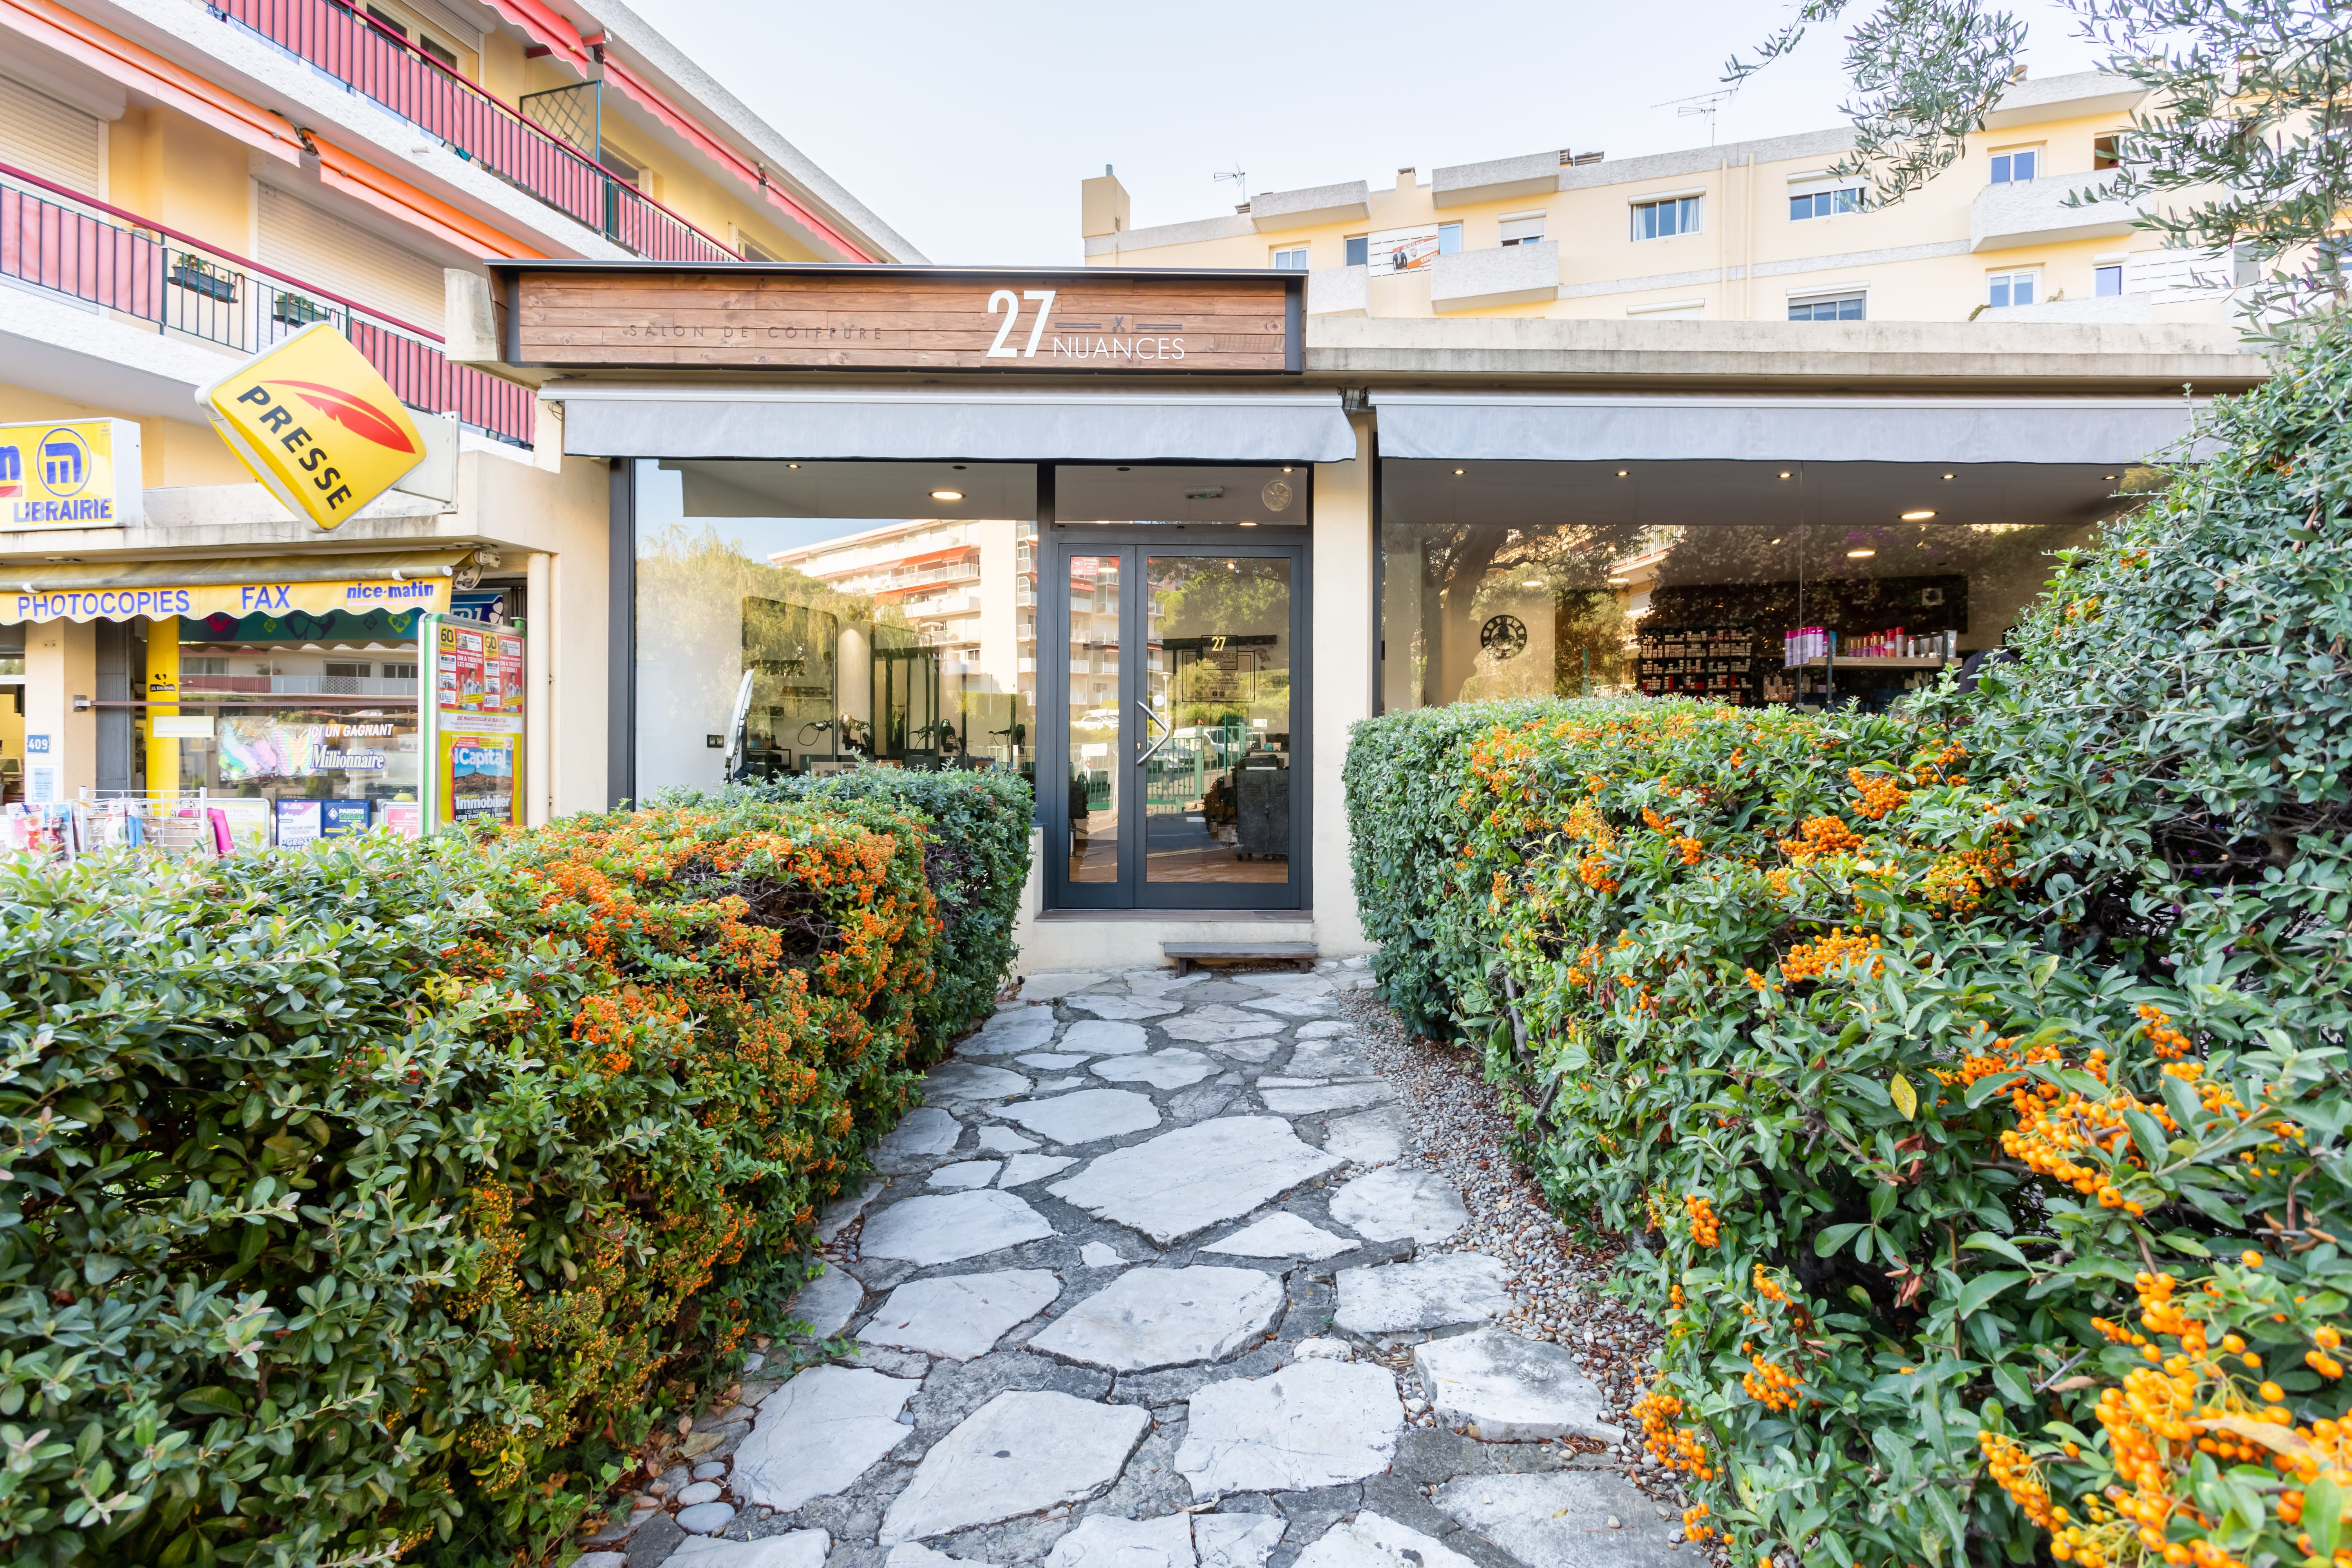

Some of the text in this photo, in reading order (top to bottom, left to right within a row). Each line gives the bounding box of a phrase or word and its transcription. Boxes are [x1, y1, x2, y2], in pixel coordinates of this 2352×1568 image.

[630, 324, 881, 339] SALON DE COIFFURE
[986, 290, 1056, 358] 27
[1054, 337, 1184, 360] NUANCES
[237, 385, 352, 510] PRESSE
[14, 498, 112, 523] LIBRAIRIE
[347, 581, 434, 599] nice-matin
[18, 585, 291, 617] PHOTOCOPIES FAX
[441, 629, 454, 643] 60
[485, 636, 497, 649] 60
[1211, 637, 1226, 651] 27
[325, 725, 340, 737] UN
[343, 724, 394, 737] GAGNANT
[28, 738, 48, 750] 409
[310, 744, 385, 769] Millionnaire
[459, 748, 506, 768] Capital
[456, 794, 511, 810] Immobilier
